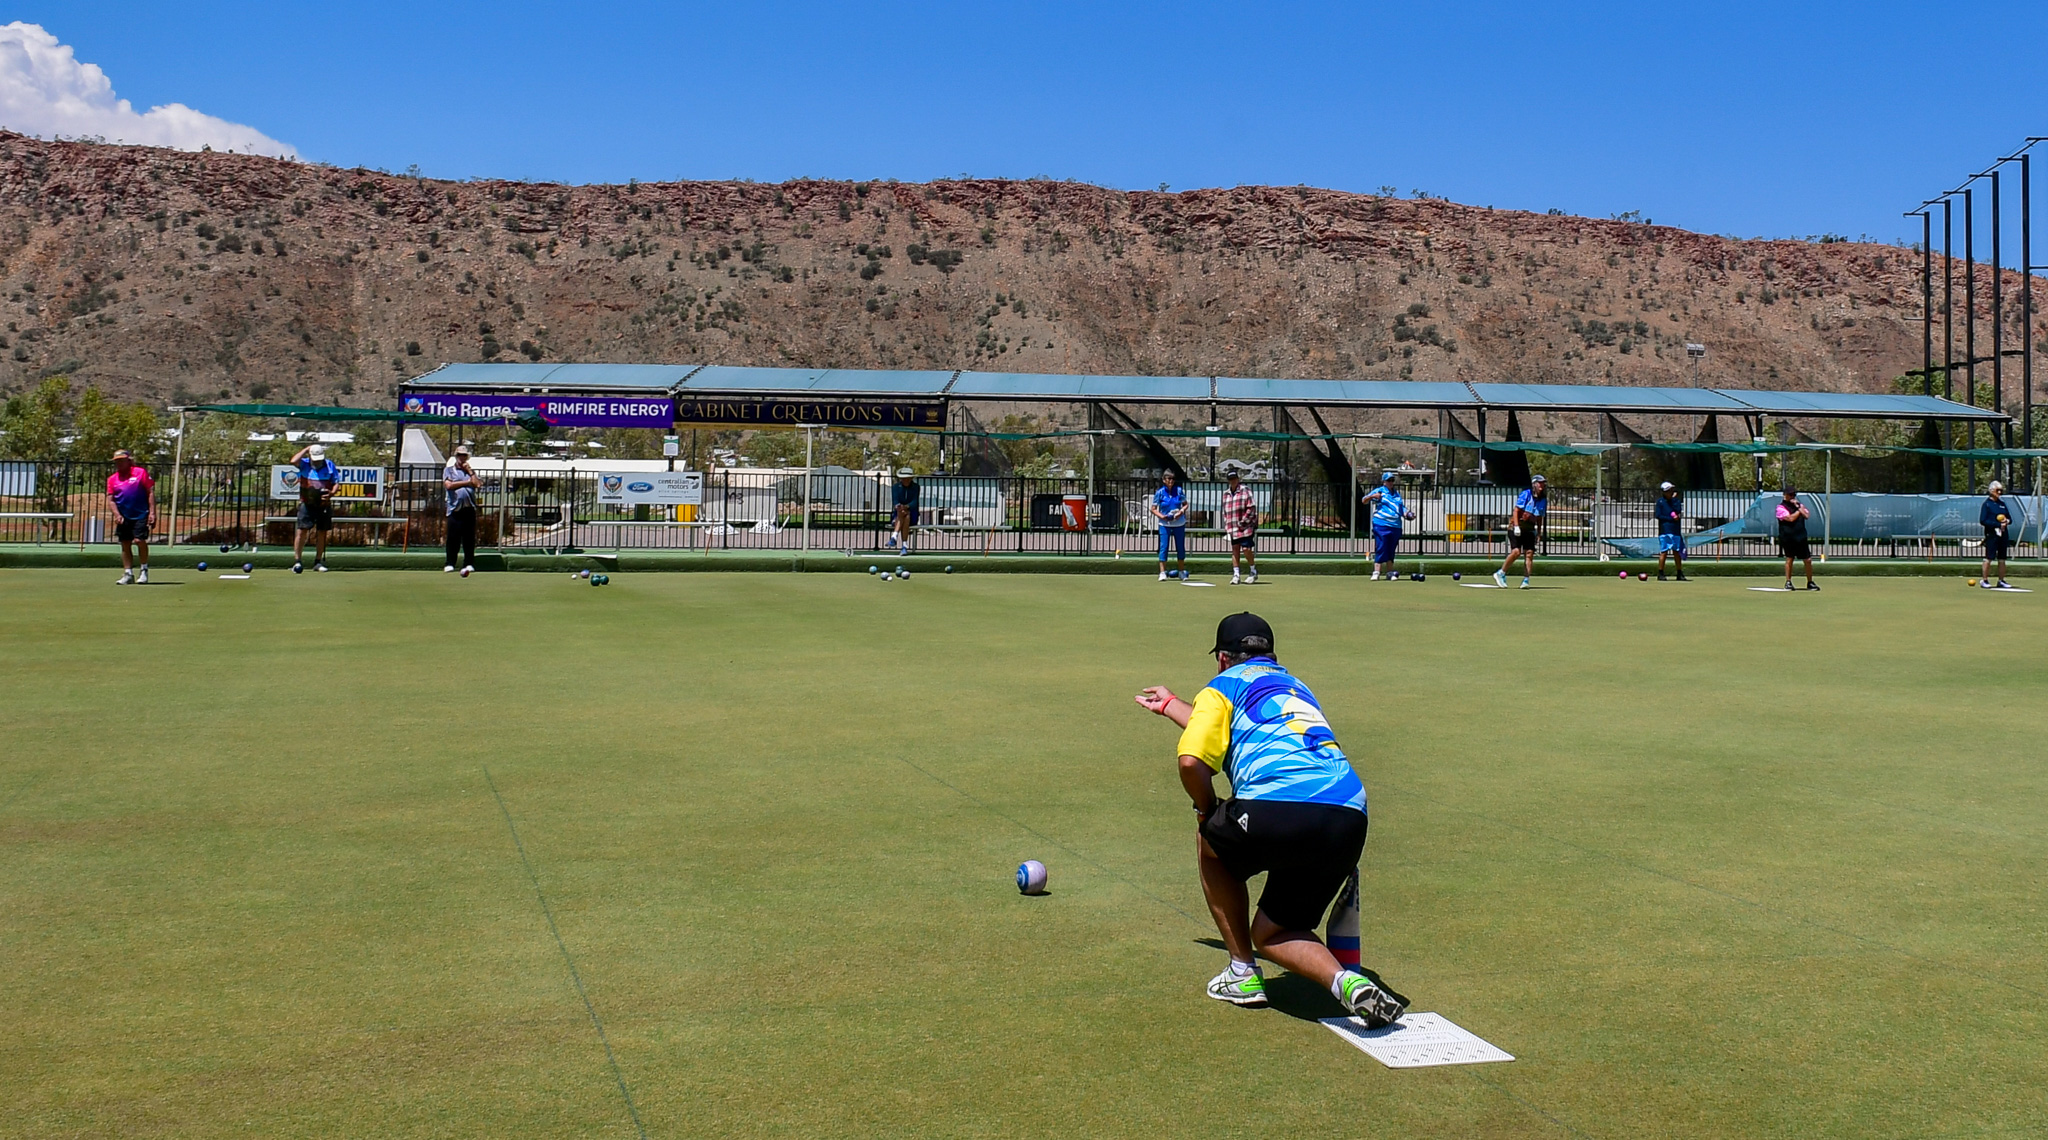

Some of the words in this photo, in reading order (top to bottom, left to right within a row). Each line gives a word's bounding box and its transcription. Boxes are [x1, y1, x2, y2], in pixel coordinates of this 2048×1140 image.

[427, 402, 457, 417] The
[460, 403, 512, 418] Range
[547, 402, 607, 416] RIMFIRE
[609, 403, 670, 417] ENERGY
[679, 402, 763, 419] CABINET
[771, 404, 883, 423] CREATIONS
[893, 406, 918, 422] NT
[338, 469, 377, 482] PLUM
